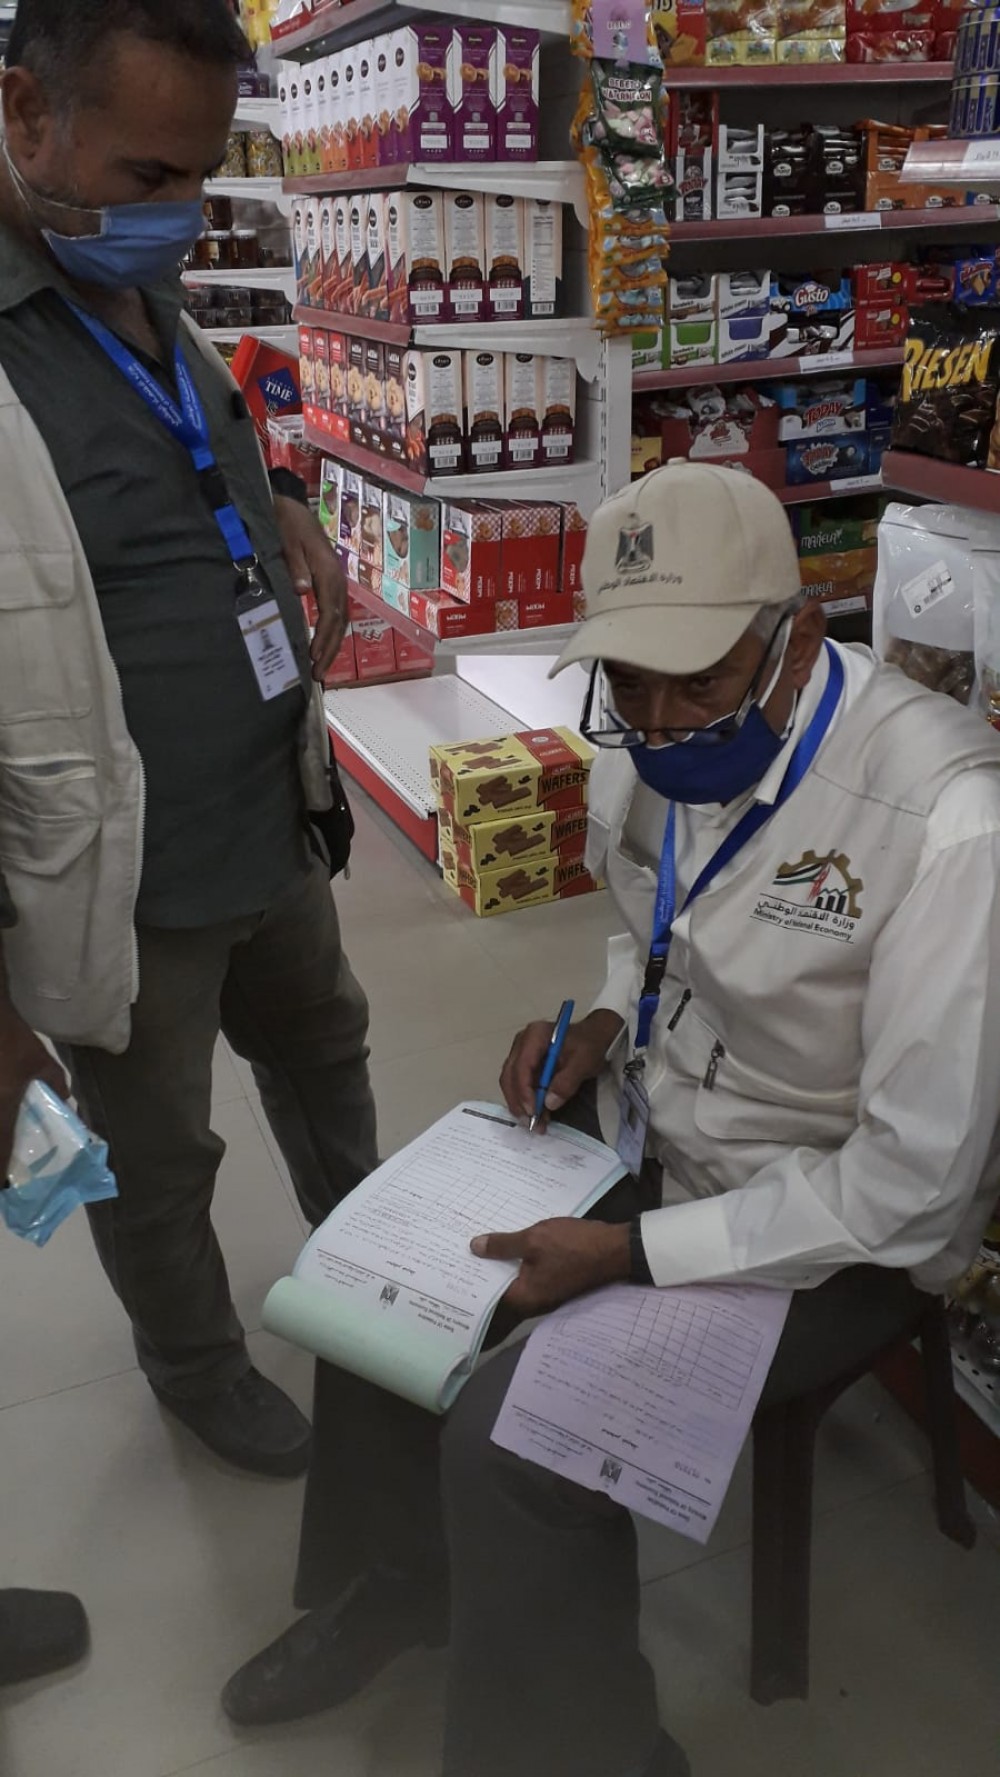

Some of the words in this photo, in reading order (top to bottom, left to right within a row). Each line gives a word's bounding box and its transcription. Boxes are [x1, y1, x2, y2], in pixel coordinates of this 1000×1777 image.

[902, 338, 995, 403] RIESEN
[265, 380, 293, 402] TIME
[543, 772, 586, 792] WAFERS
[557, 866, 590, 883] WAFE
[757, 901, 797, 916] الوطني
[753, 907, 783, 924] Ministry
[814, 923, 852, 941] Economy
[832, 915, 855, 931] وزارة
